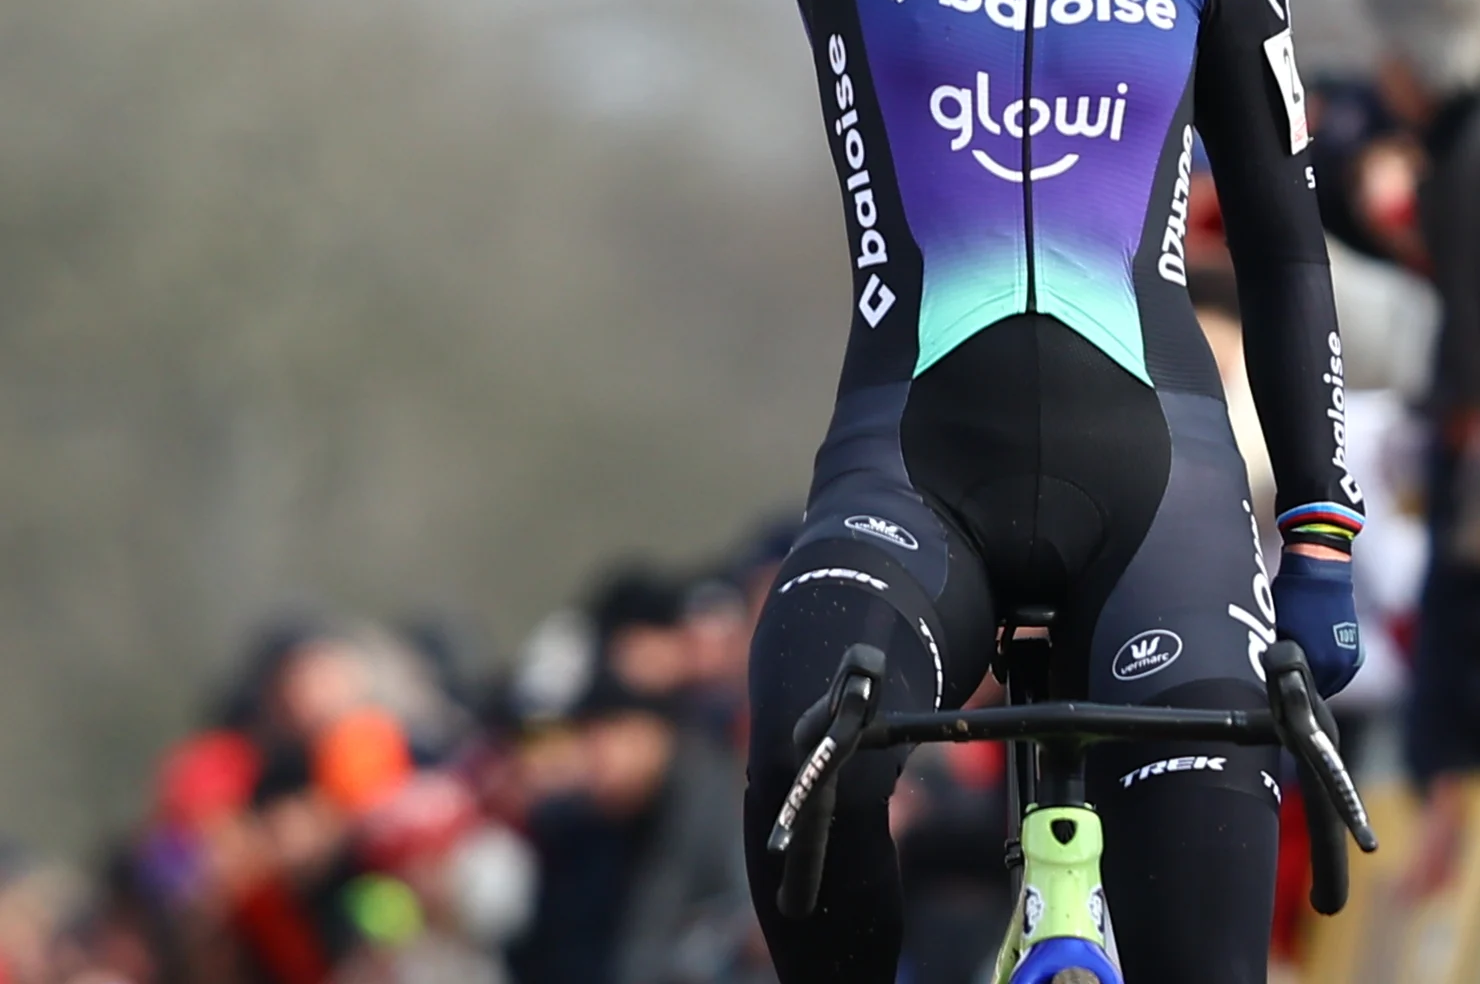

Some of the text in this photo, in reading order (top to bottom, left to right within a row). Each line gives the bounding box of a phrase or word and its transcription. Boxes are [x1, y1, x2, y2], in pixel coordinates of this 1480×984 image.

[828, 33, 888, 268] baloise
[929, 70, 1126, 151] glowi
[1323, 331, 1348, 474] baloise
[1121, 652, 1170, 675] vermarc
[779, 736, 837, 831] SRAM
[1119, 756, 1227, 788] TREK
